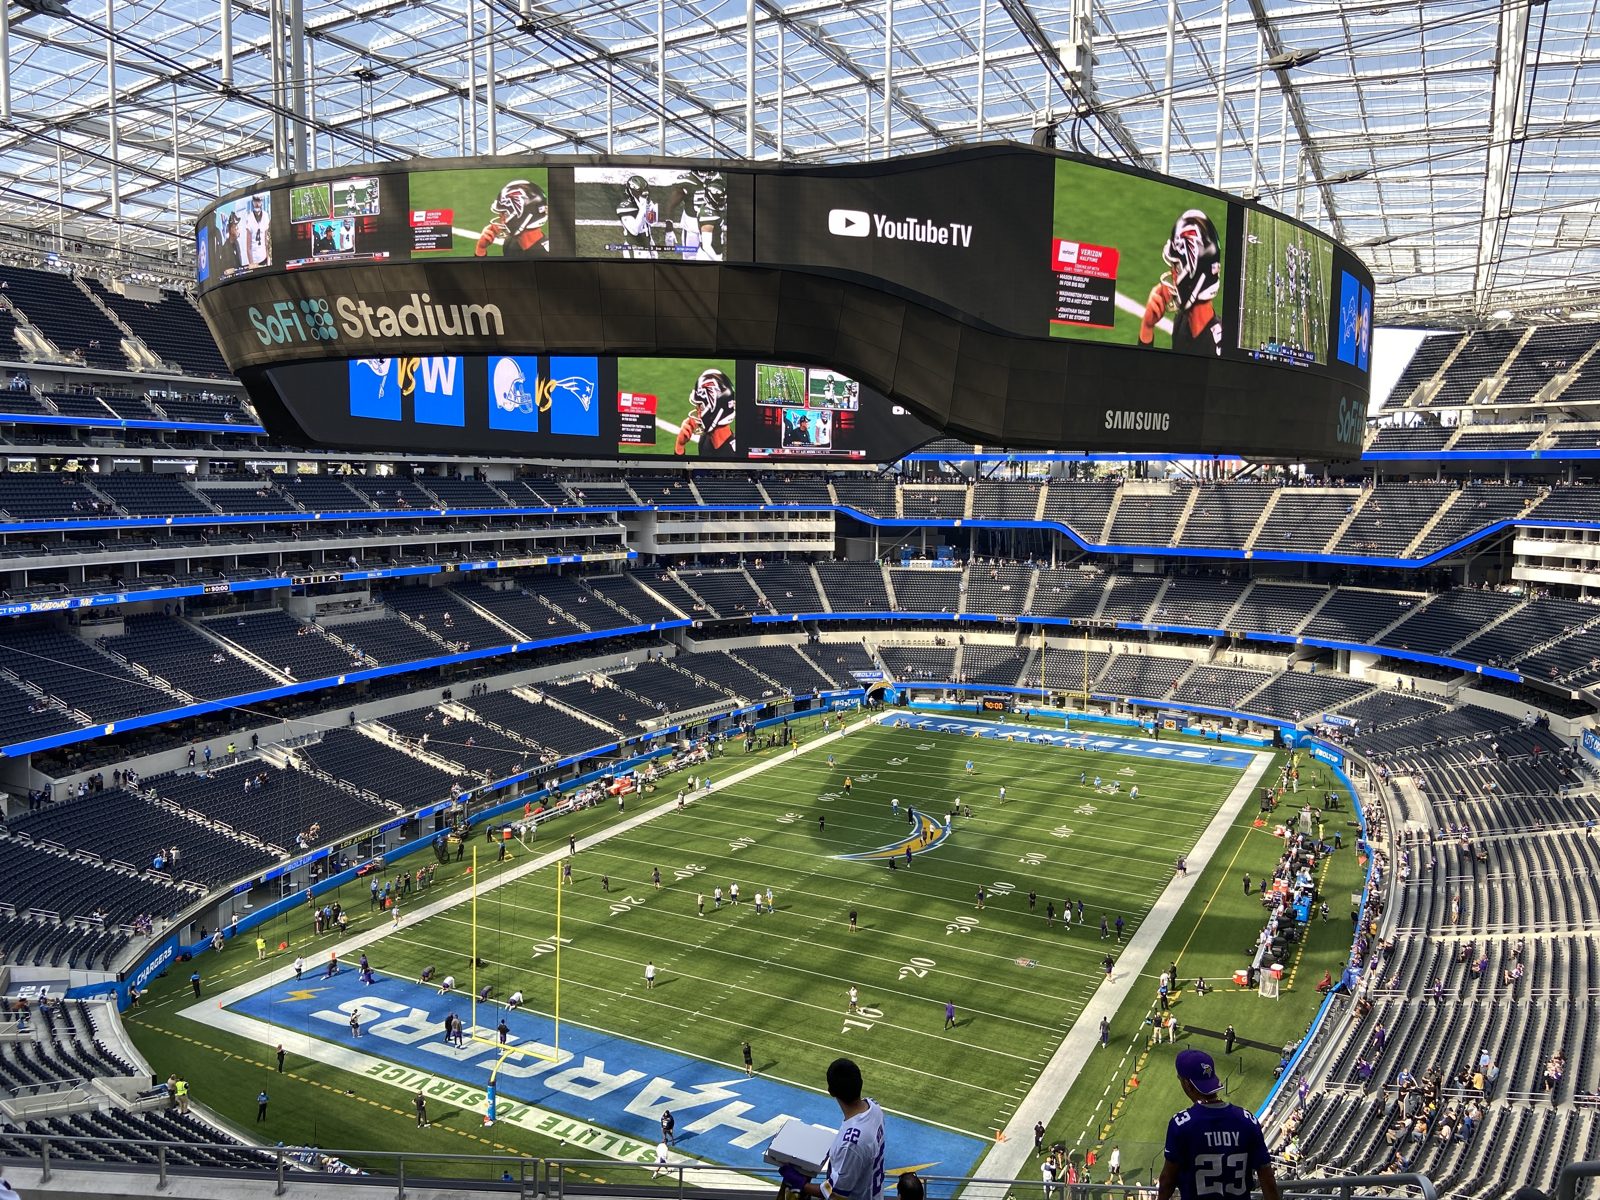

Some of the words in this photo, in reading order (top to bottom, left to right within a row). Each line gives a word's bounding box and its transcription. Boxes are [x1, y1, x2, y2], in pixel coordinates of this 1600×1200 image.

[873, 213, 949, 245] YouTube
[950, 223, 973, 248] TV
[1081, 249, 1102, 258] VERIZON
[248, 301, 306, 346] SoFi
[336, 292, 505, 339] Stadium
[397, 358, 421, 396] VS
[535, 374, 557, 412] VS
[1105, 409, 1170, 432] SAMSUNG
[985, 701, 1003, 710] 90:00
[1325, 716, 1352, 726] #BOLTU
[340, 838, 353, 849] LOS
[353, 829, 380, 845] ANGELES
[136, 945, 173, 986] CHARGERS
[898, 957, 936, 979] 20
[309, 996, 838, 1172] HARGERS
[366, 1062, 483, 1107] SERVICE
[496, 1102, 530, 1123] TO
[535, 1115, 658, 1164] SALUTE
[843, 1127, 861, 1144] 22
[1204, 1131, 1240, 1147] TUDY
[1195, 1152, 1248, 1196] 23
